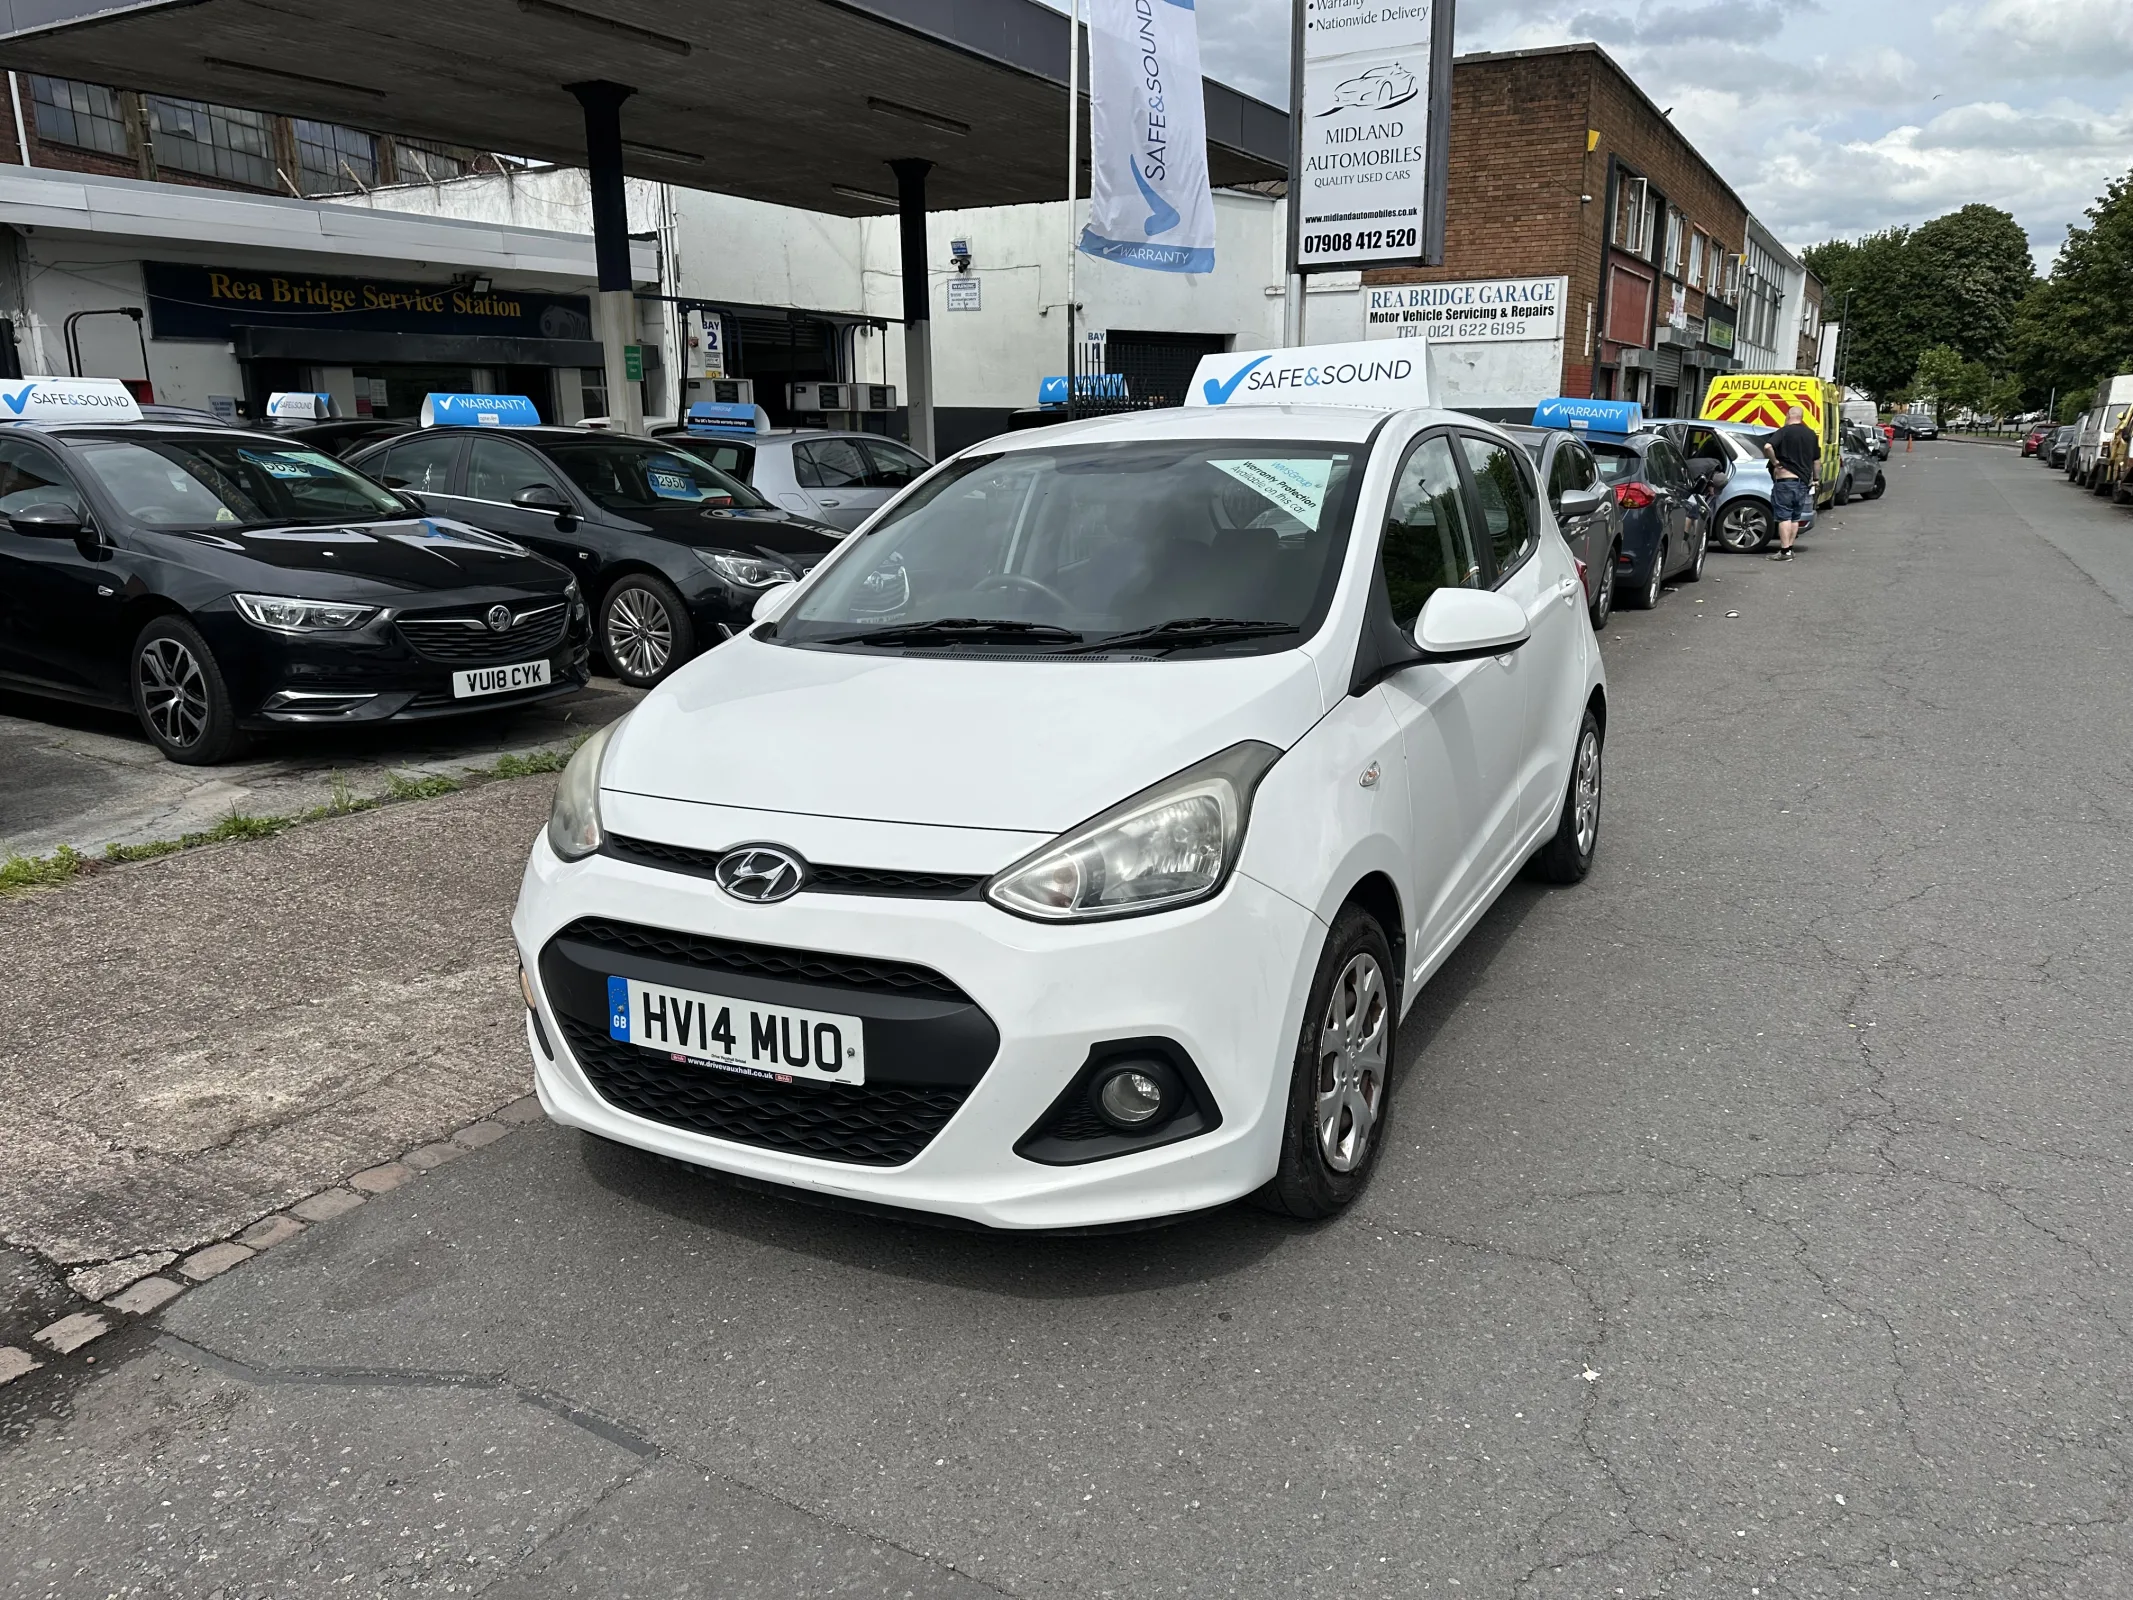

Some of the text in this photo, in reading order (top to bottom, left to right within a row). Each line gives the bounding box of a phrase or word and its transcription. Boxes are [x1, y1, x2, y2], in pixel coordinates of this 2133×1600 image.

[1317, 0, 1364, 10] Warranty
[1316, 6, 1429, 31] Nationwide Delivery
[1136, 0, 1166, 181] SAFE&SOUND
[1326, 121, 1403, 144] MIDLAND
[1306, 145, 1422, 171] AUTOMOBILES
[1314, 170, 1411, 188] QUALITY USED CARS
[1305, 207, 1417, 223] www.midlandautomobiles.co.uk
[1304, 228, 1416, 253] 07908 412 520
[1120, 246, 1190, 264] WARRANTY
[208, 273, 521, 317] Rea Bridge Service Station
[1371, 283, 1555, 308] REA BRIDGE GARAGE
[1369, 304, 1554, 323] Motor Vehicle Servicing & Repairs
[702, 321, 719, 331] BAY
[1428, 324, 1454, 338] 0121
[1459, 323, 1487, 337] 622
[1491, 321, 1526, 335] 6195
[707, 332, 718, 350] 2
[1088, 332, 1105, 340] BAY
[1248, 359, 1412, 391] SAFE&SOUND
[1721, 380, 1807, 391] AMBULANCE
[32, 393, 129, 407] SAFE&SOUND
[456, 398, 526, 410] WARRANTY
[1559, 405, 1623, 419] WARRANTY
[1231, 466, 1306, 514] Available on this car
[1243, 461, 1316, 508] Warranty Protection
[466, 664, 541, 692] VU18 CYK
[613, 1015, 627, 1029] GB
[643, 992, 842, 1073] HV14 MUO
[688, 1057, 773, 1080] www.drivevauxhall.co.uk
